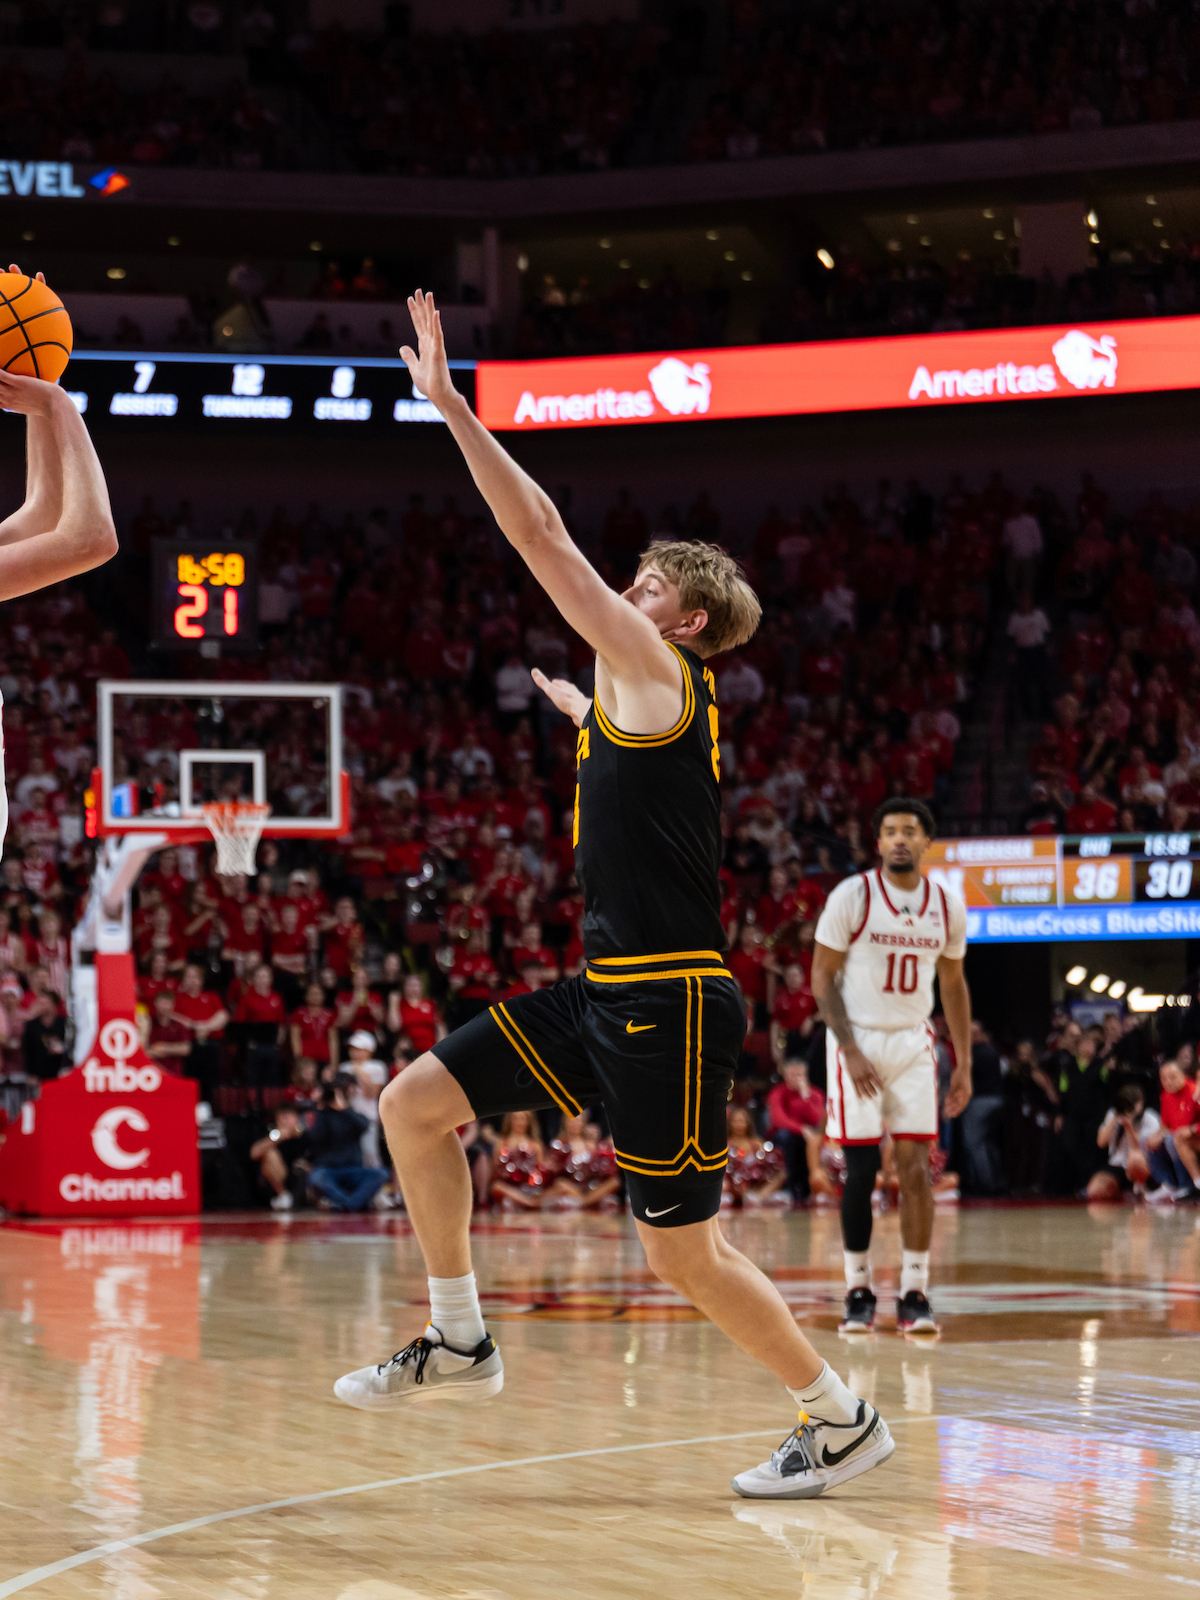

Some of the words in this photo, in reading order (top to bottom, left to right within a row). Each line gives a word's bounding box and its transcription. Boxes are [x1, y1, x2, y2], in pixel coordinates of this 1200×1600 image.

[133, 361, 156, 393] 7
[908, 360, 1057, 400] Ameritas
[109, 392, 179, 416] ASSISTS
[202, 394, 292, 419] TURNOVERS
[313, 397, 373, 421] STEALS
[513, 386, 654, 424] Ameritas
[174, 583, 238, 638] 21
[956, 839, 1034, 861] NEBRASKA
[996, 866, 1055, 885] TIMEOUTS
[1073, 862, 1120, 900] 36
[1145, 860, 1193, 898] 30
[1010, 885, 1051, 903] FOULS
[986, 911, 1102, 937] BlueCross
[1107, 907, 1200, 933] BlueShi
[870, 932, 940, 949] NEBRASKA
[882, 952, 919, 995] 10
[81, 1057, 162, 1093] fnbo
[59, 1170, 185, 1202] Channel
